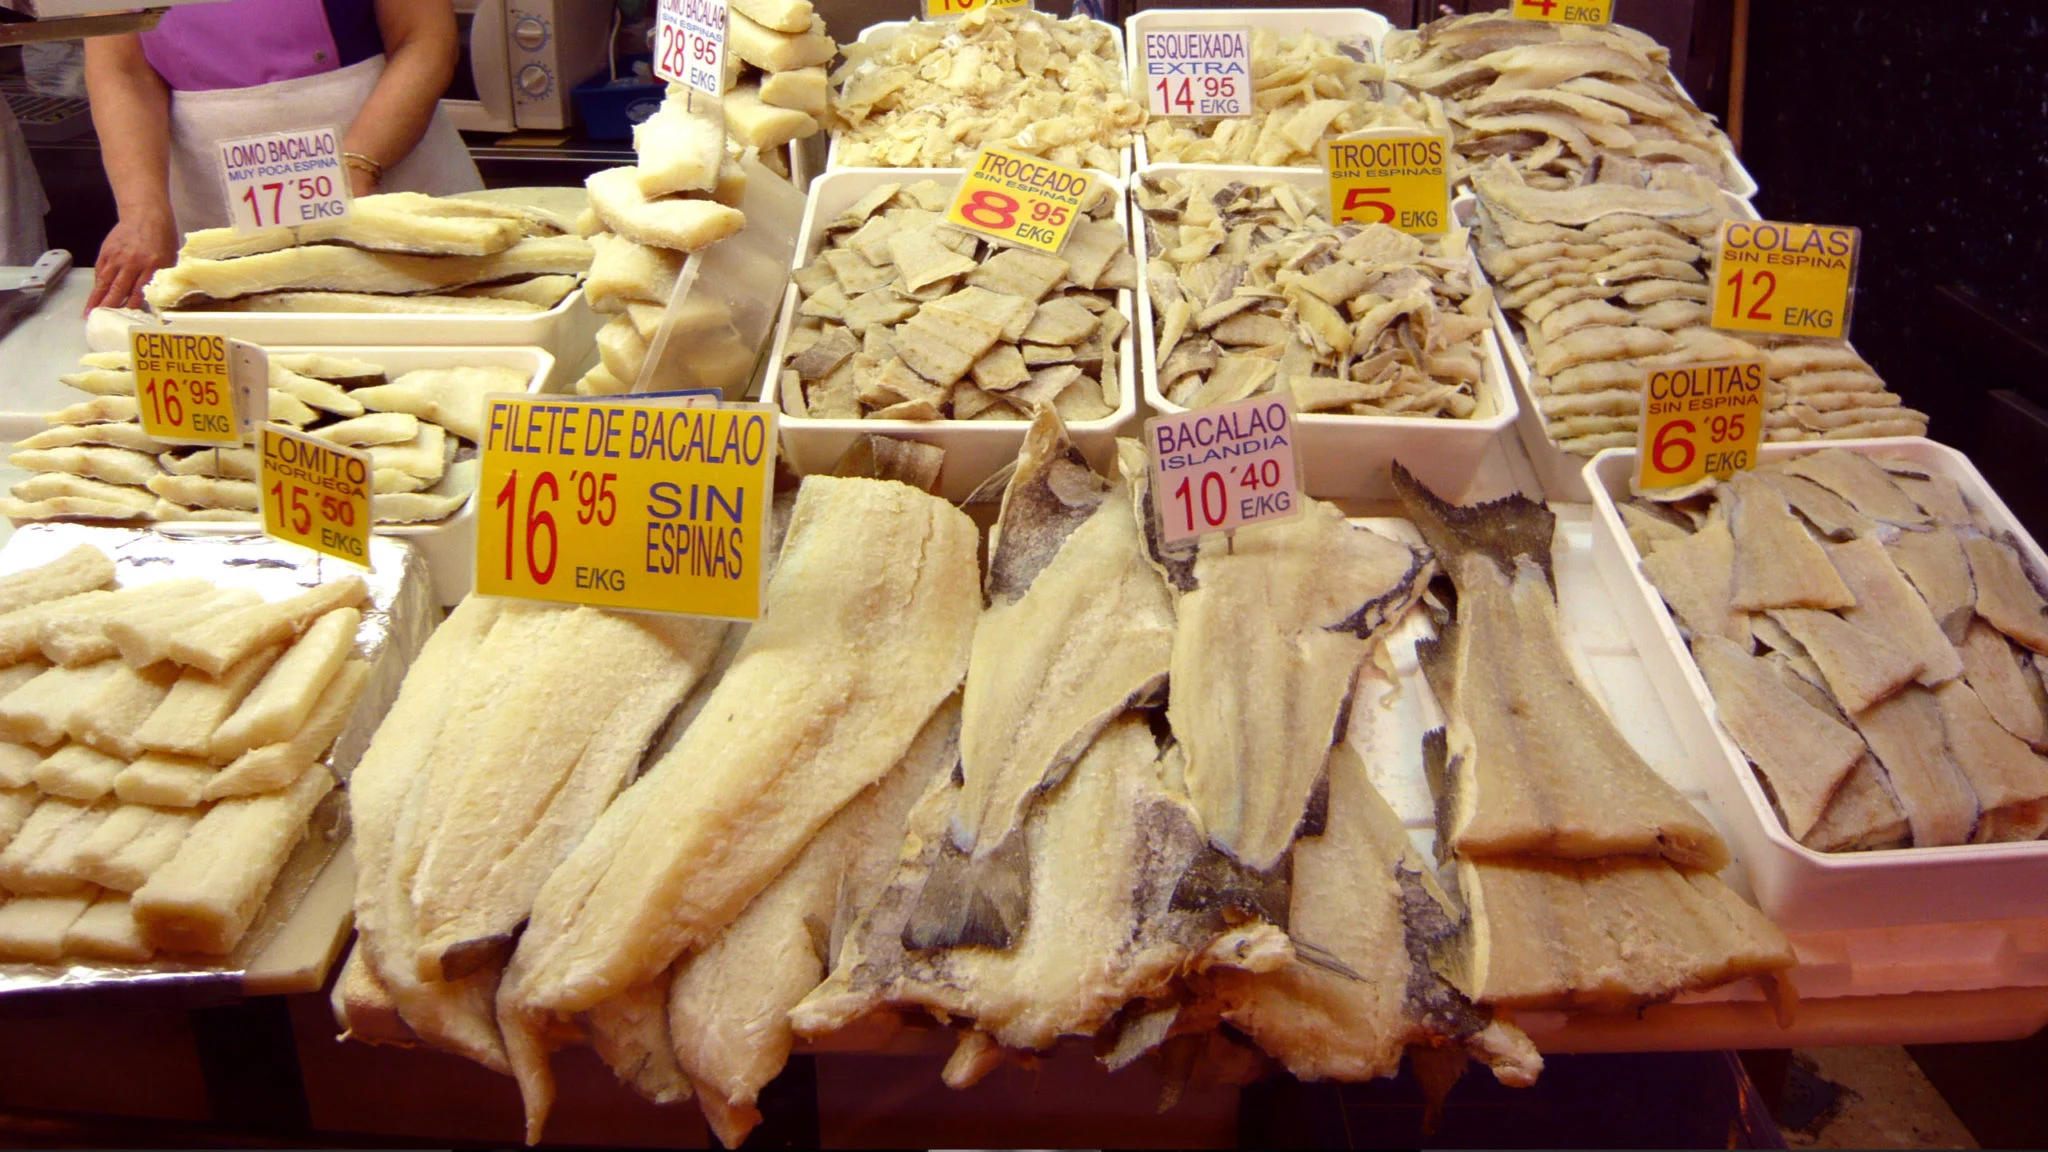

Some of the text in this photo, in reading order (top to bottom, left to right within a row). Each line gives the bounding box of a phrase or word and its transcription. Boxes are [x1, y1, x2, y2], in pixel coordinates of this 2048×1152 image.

[1564, 6, 1601, 22] E/KG
[1146, 33, 1245, 60] ESQUEIXADA
[1148, 62, 1245, 75] EXTRA
[1200, 99, 1240, 114] E/KG
[223, 133, 335, 169] LOMO BACALAO
[1330, 141, 1442, 168] TROCITOS
[229, 157, 338, 181] MUY POCA ESPINA
[980, 152, 1086, 197] TROCEADO
[1332, 167, 1442, 178] SIN ESPINAS
[973, 171, 1078, 205] SIN ESPINAS
[300, 200, 345, 221] E/KG
[1341, 187, 1396, 224] 5
[1400, 210, 1438, 228] E/KG
[1016, 223, 1055, 245] E/KG
[1726, 223, 1850, 256] COLAS
[1724, 250, 1847, 269] SIN ESPINA
[1727, 268, 1777, 320] 12
[1783, 307, 1833, 329] E/KG
[135, 333, 225, 362] CENTROS
[137, 360, 226, 375] DE FILETE
[1650, 363, 1762, 400] COLITAS
[1649, 394, 1759, 415] SIN ESPINA
[192, 413, 230, 433] E/KG
[488, 403, 766, 466] FILETE DE BACALAO
[1156, 402, 1288, 455] BACALAO
[263, 430, 366, 485] LOMITO
[1160, 435, 1289, 472] ISLANDIA
[1704, 449, 1748, 474] E/KG
[264, 459, 366, 500] NORUEGA
[647, 481, 744, 524] SIN
[1240, 491, 1291, 520] E/KG
[321, 527, 364, 557] E/KG
[646, 521, 743, 580] ESPINAS
[575, 566, 626, 592] E/KG
